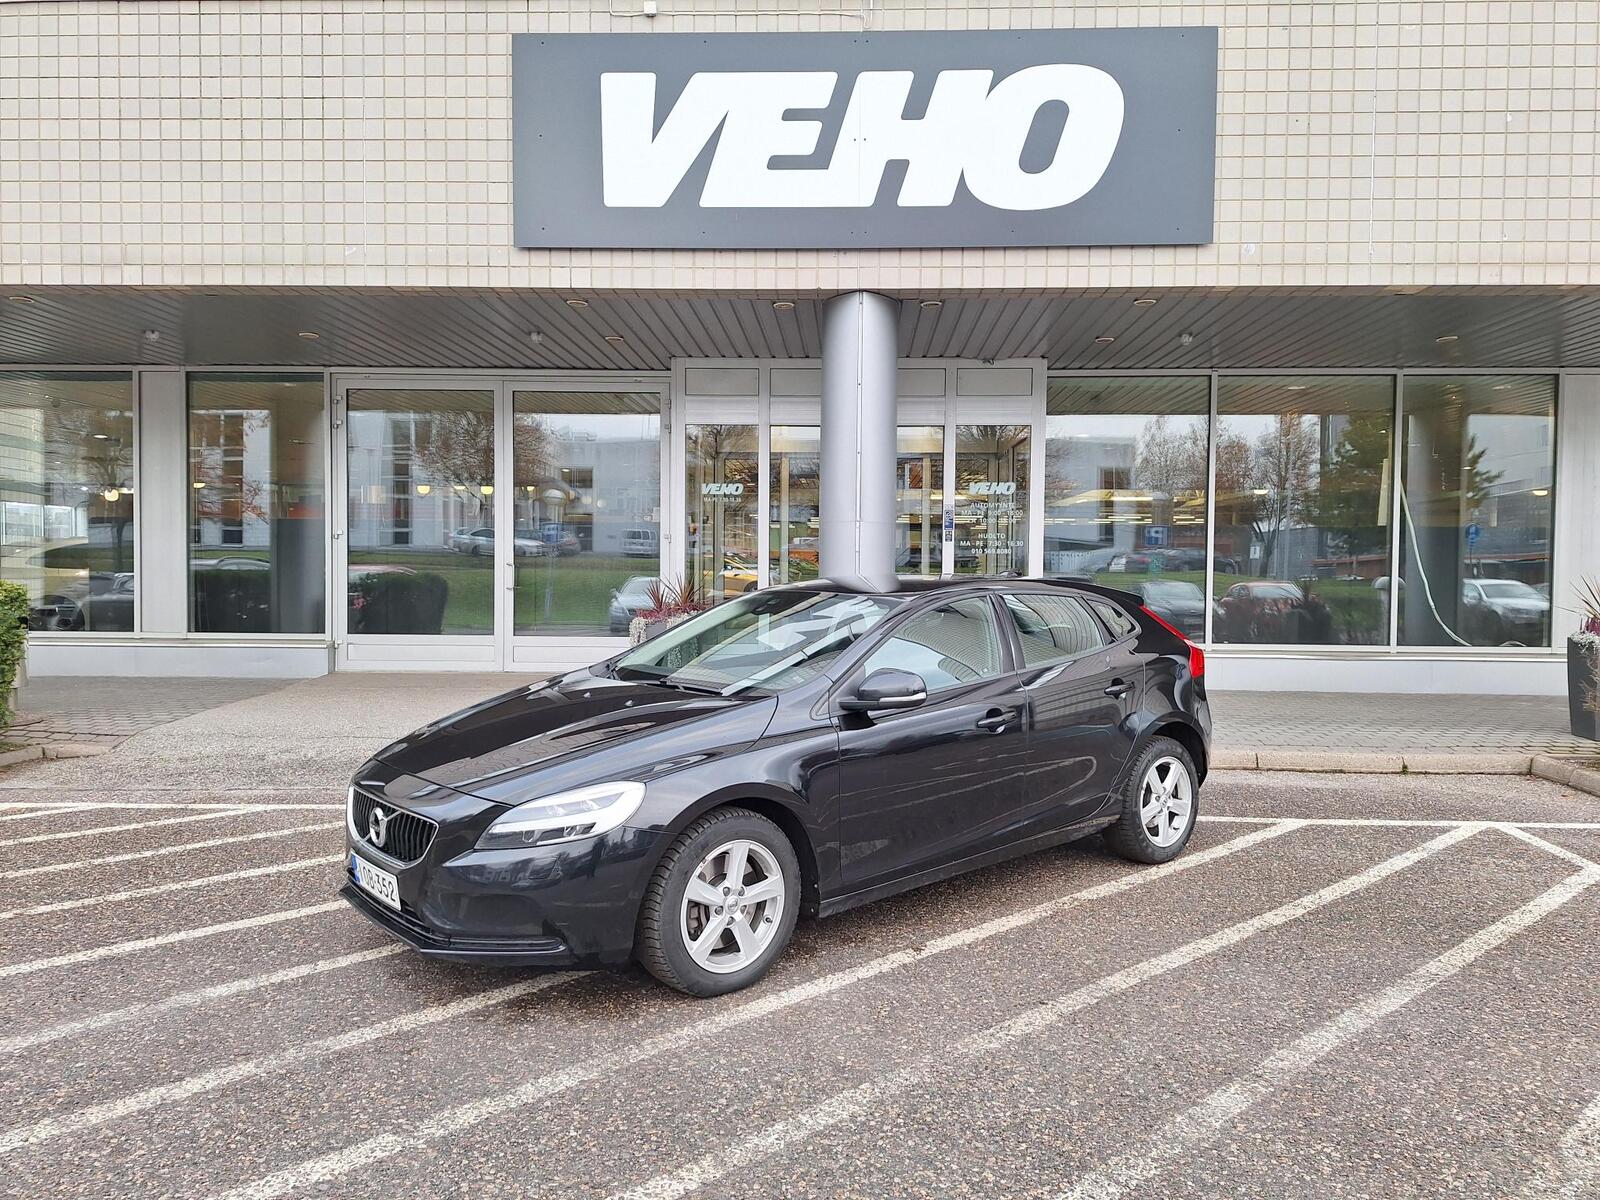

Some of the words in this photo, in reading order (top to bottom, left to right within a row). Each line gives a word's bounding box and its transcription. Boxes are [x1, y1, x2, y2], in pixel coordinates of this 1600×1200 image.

[601, 63, 1125, 211] VEHO
[702, 483, 744, 495] VEHO
[968, 482, 1017, 495] VEHO
